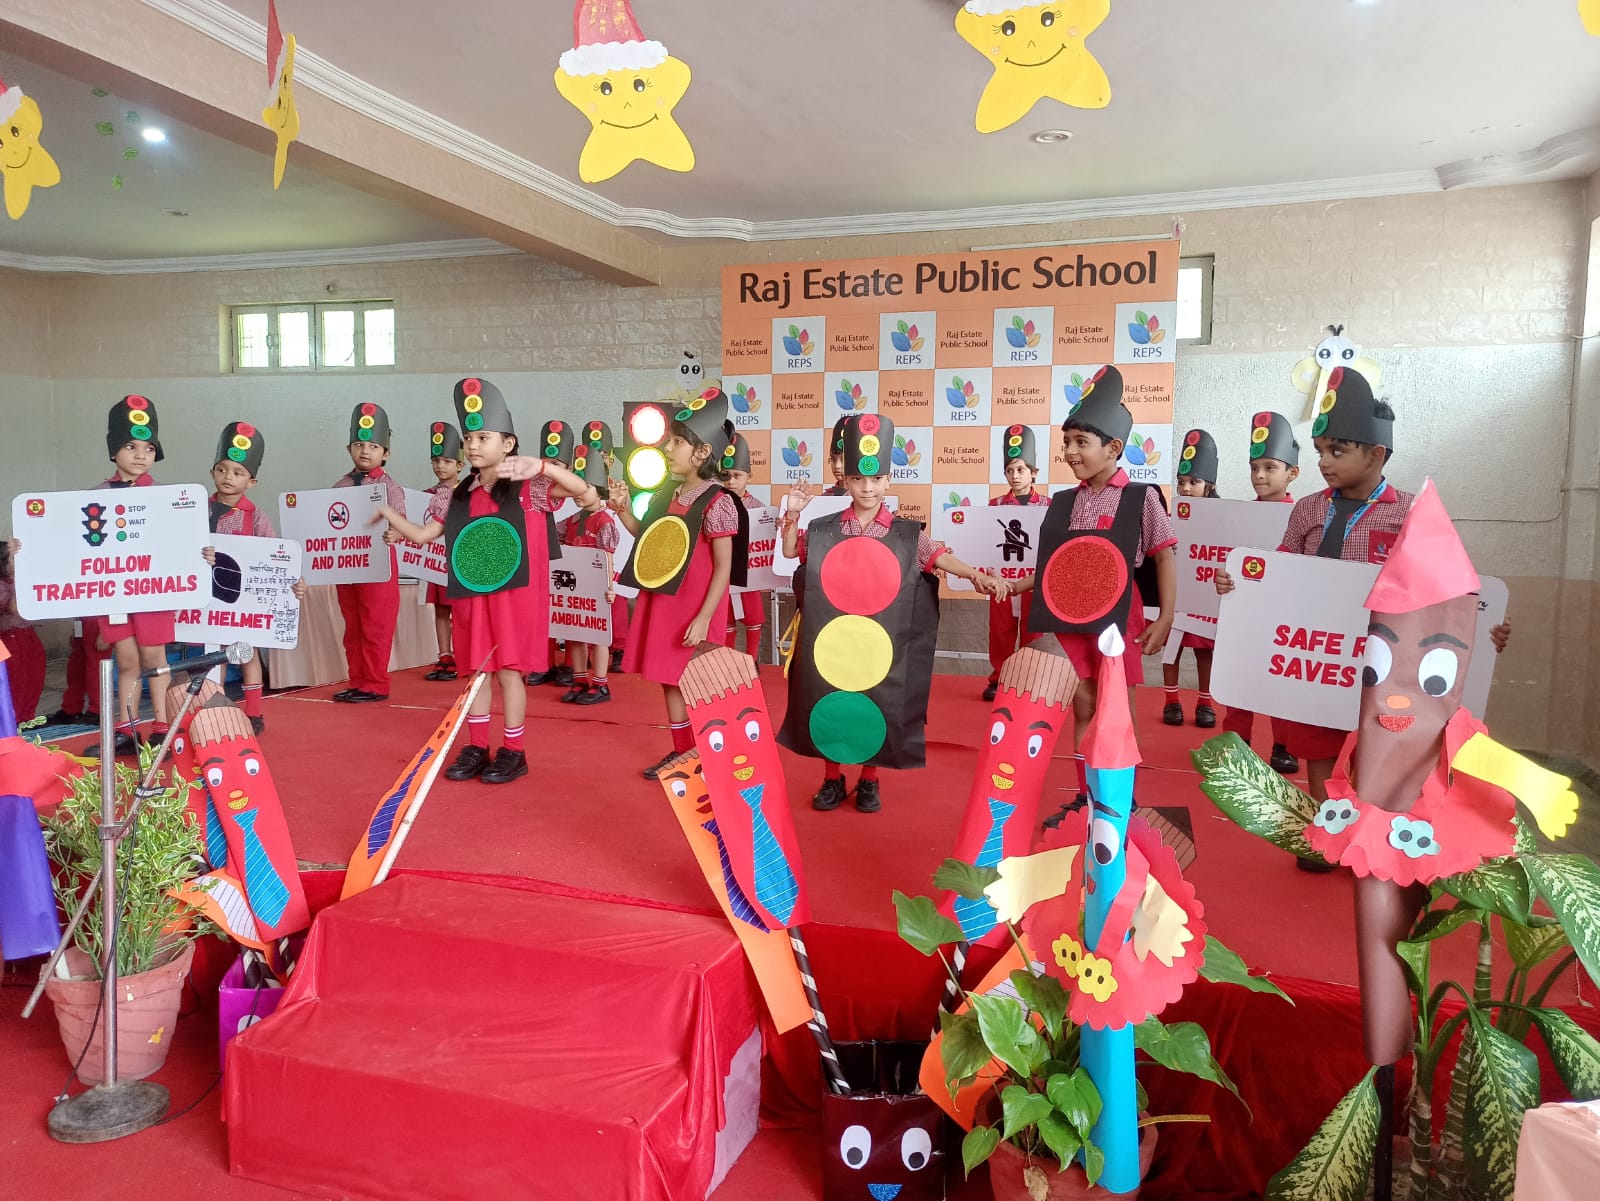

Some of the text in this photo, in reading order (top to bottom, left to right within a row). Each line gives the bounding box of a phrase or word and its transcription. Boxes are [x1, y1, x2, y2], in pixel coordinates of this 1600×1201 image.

[740, 251, 1157, 309] Raj Estate Public School
[946, 330, 982, 339] Raj Estate
[1065, 325, 1103, 335] Raj Estate
[730, 338, 763, 348] Raj Estate
[835, 334, 870, 344] Raj Estate
[940, 339, 988, 348] Public School
[1058, 335, 1109, 344] Public School
[725, 347, 768, 357] Public School
[829, 343, 875, 352] Public School
[1133, 347, 1162, 358] REPS
[895, 354, 922, 365] REPS
[1010, 350, 1038, 361] REPS
[787, 358, 812, 368] REPS
[888, 389, 924, 399] Raj Estate
[1002, 386, 1040, 396] Raj Estate
[1124, 384, 1165, 394] Raj Estate
[781, 392, 815, 401] Raj Estate
[996, 396, 1046, 405] Public School
[1123, 394, 1170, 403] ublic School
[776, 401, 820, 410] Public School
[883, 398, 929, 407] Public School
[735, 416, 759, 425] REPS
[951, 411, 977, 421] REPS
[943, 446, 980, 455] Raj Estate
[937, 456, 985, 464] Public School
[786, 469, 810, 479] REPS
[893, 469, 919, 479] REPS
[1129, 468, 1158, 479] REPS
[128, 505, 147, 513] STOP
[900, 503, 921, 511] Estate
[129, 518, 146, 526] WAIT
[306, 535, 372, 553] DON'T DRINK
[312, 553, 370, 570] AND DRIVE
[403, 551, 422, 566] BUT
[80, 554, 152, 576] FOLLOW
[33, 574, 198, 602] TRAFFIC SIGNALS
[567, 595, 597, 612] SENSE
[174, 609, 202, 624] AR
[207, 610, 275, 630] HELMET
[551, 611, 608, 632] AMBULANCE
[1273, 624, 1368, 658] SAFE R
[1268, 653, 1357, 688] SAVES
